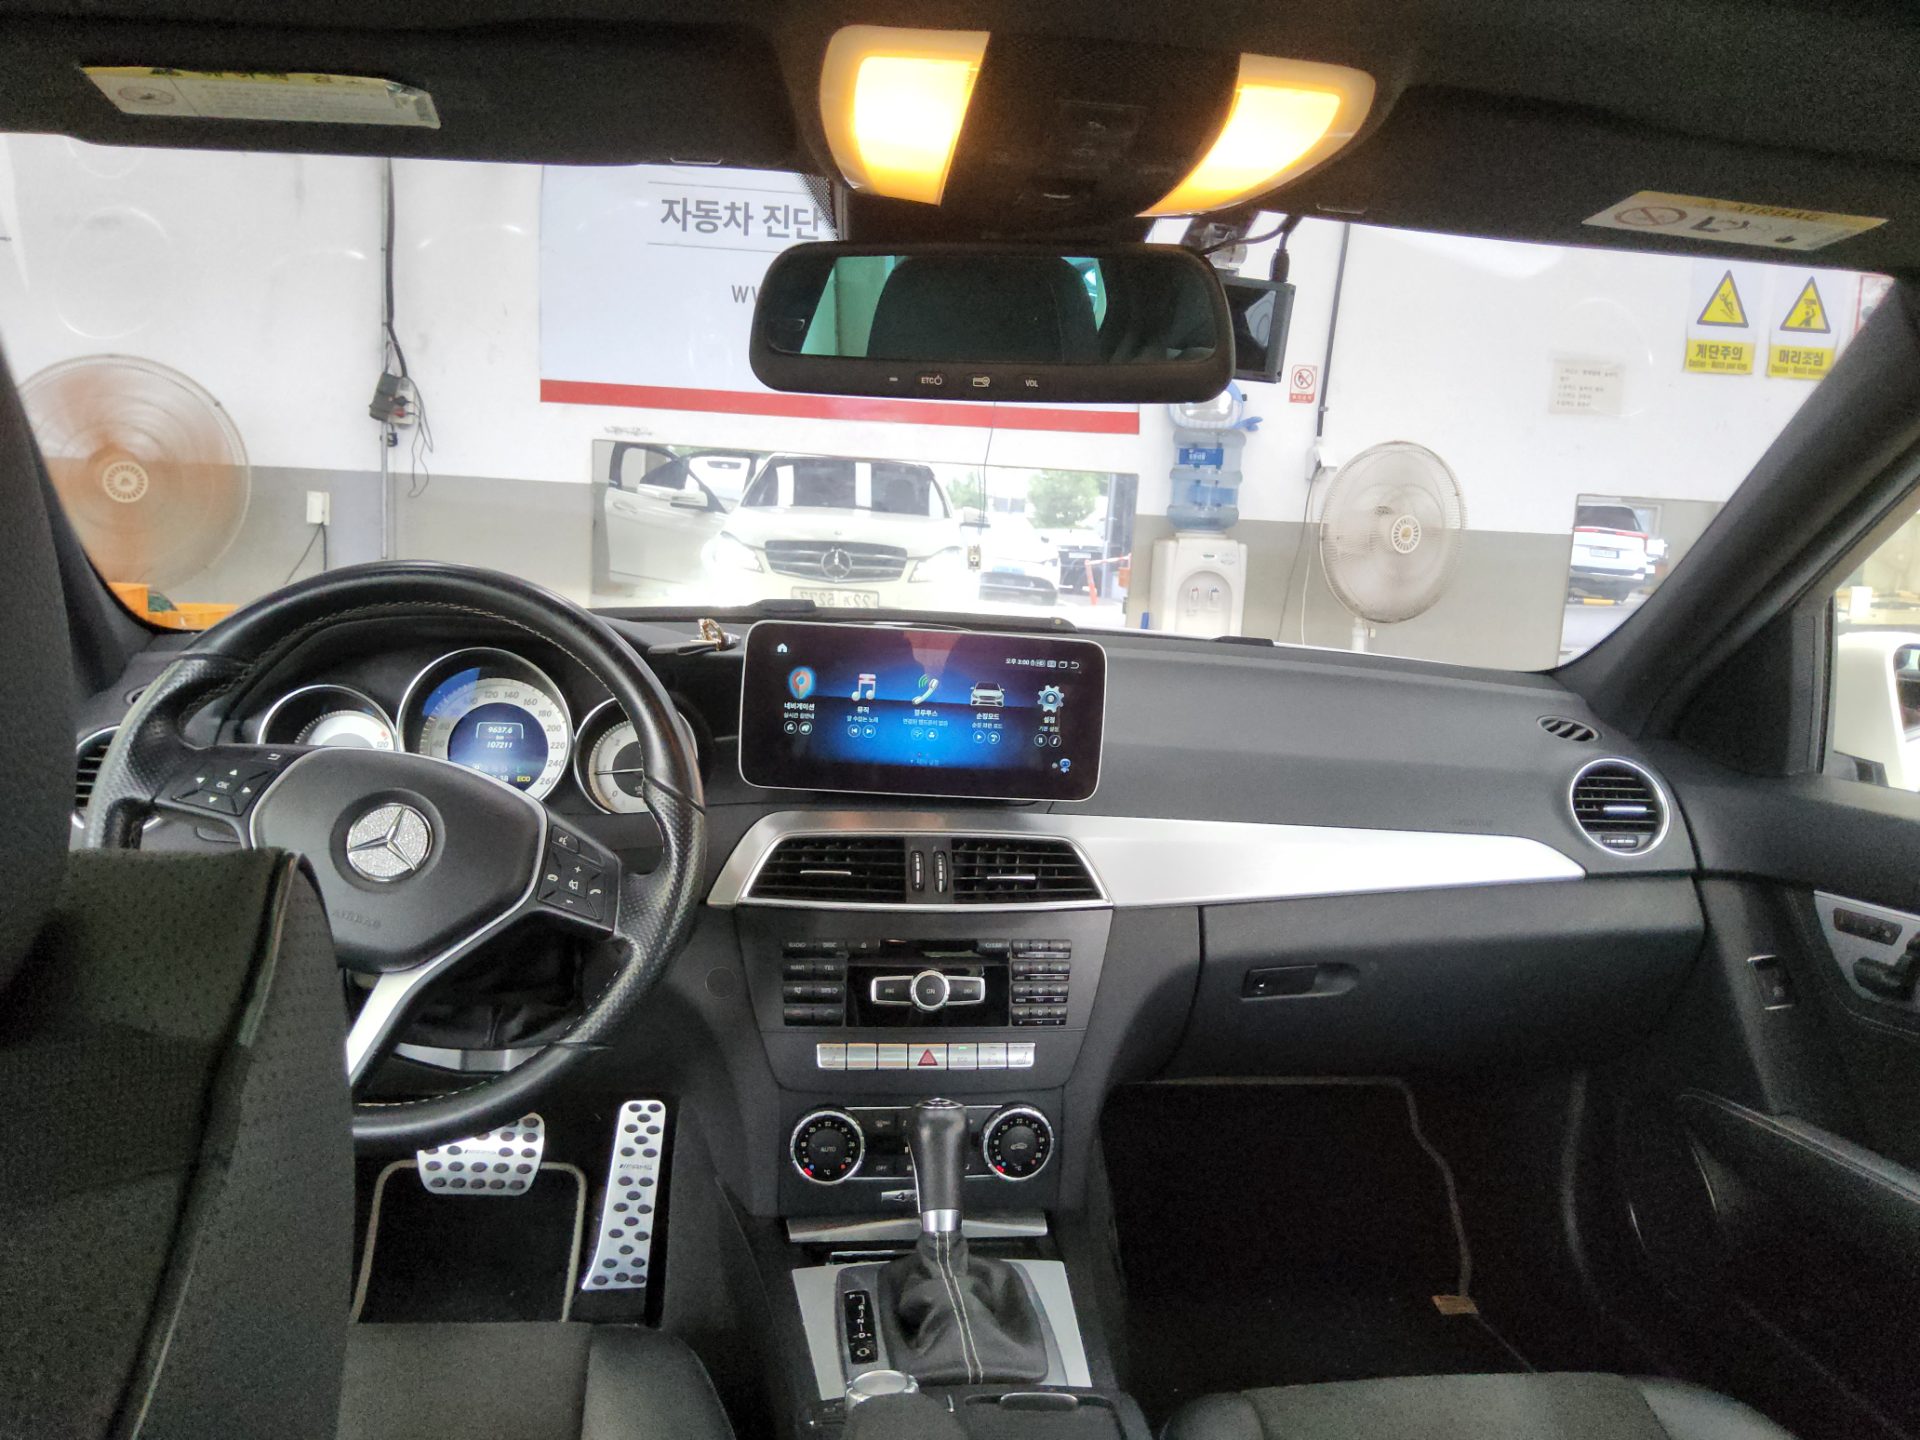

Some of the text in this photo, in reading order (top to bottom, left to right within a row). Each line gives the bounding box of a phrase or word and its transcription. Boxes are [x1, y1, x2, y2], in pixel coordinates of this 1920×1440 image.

[661, 197, 826, 240] 자동차 진단
[1696, 344, 1743, 361] 계단주의
[1779, 350, 1823, 366] 머리조심
[921, 376, 935, 384] ETC
[1025, 379, 1038, 387] VOL
[504, 690, 520, 699] 140
[523, 698, 538, 706] 160
[784, 702, 815, 711] 네비게이션
[538, 709, 552, 718] 180
[914, 709, 938, 717] 블루투스
[546, 724, 562, 732] 200
[487, 741, 513, 749] 107211
[550, 741, 565, 749] 220
[216, 781, 230, 790] OK
